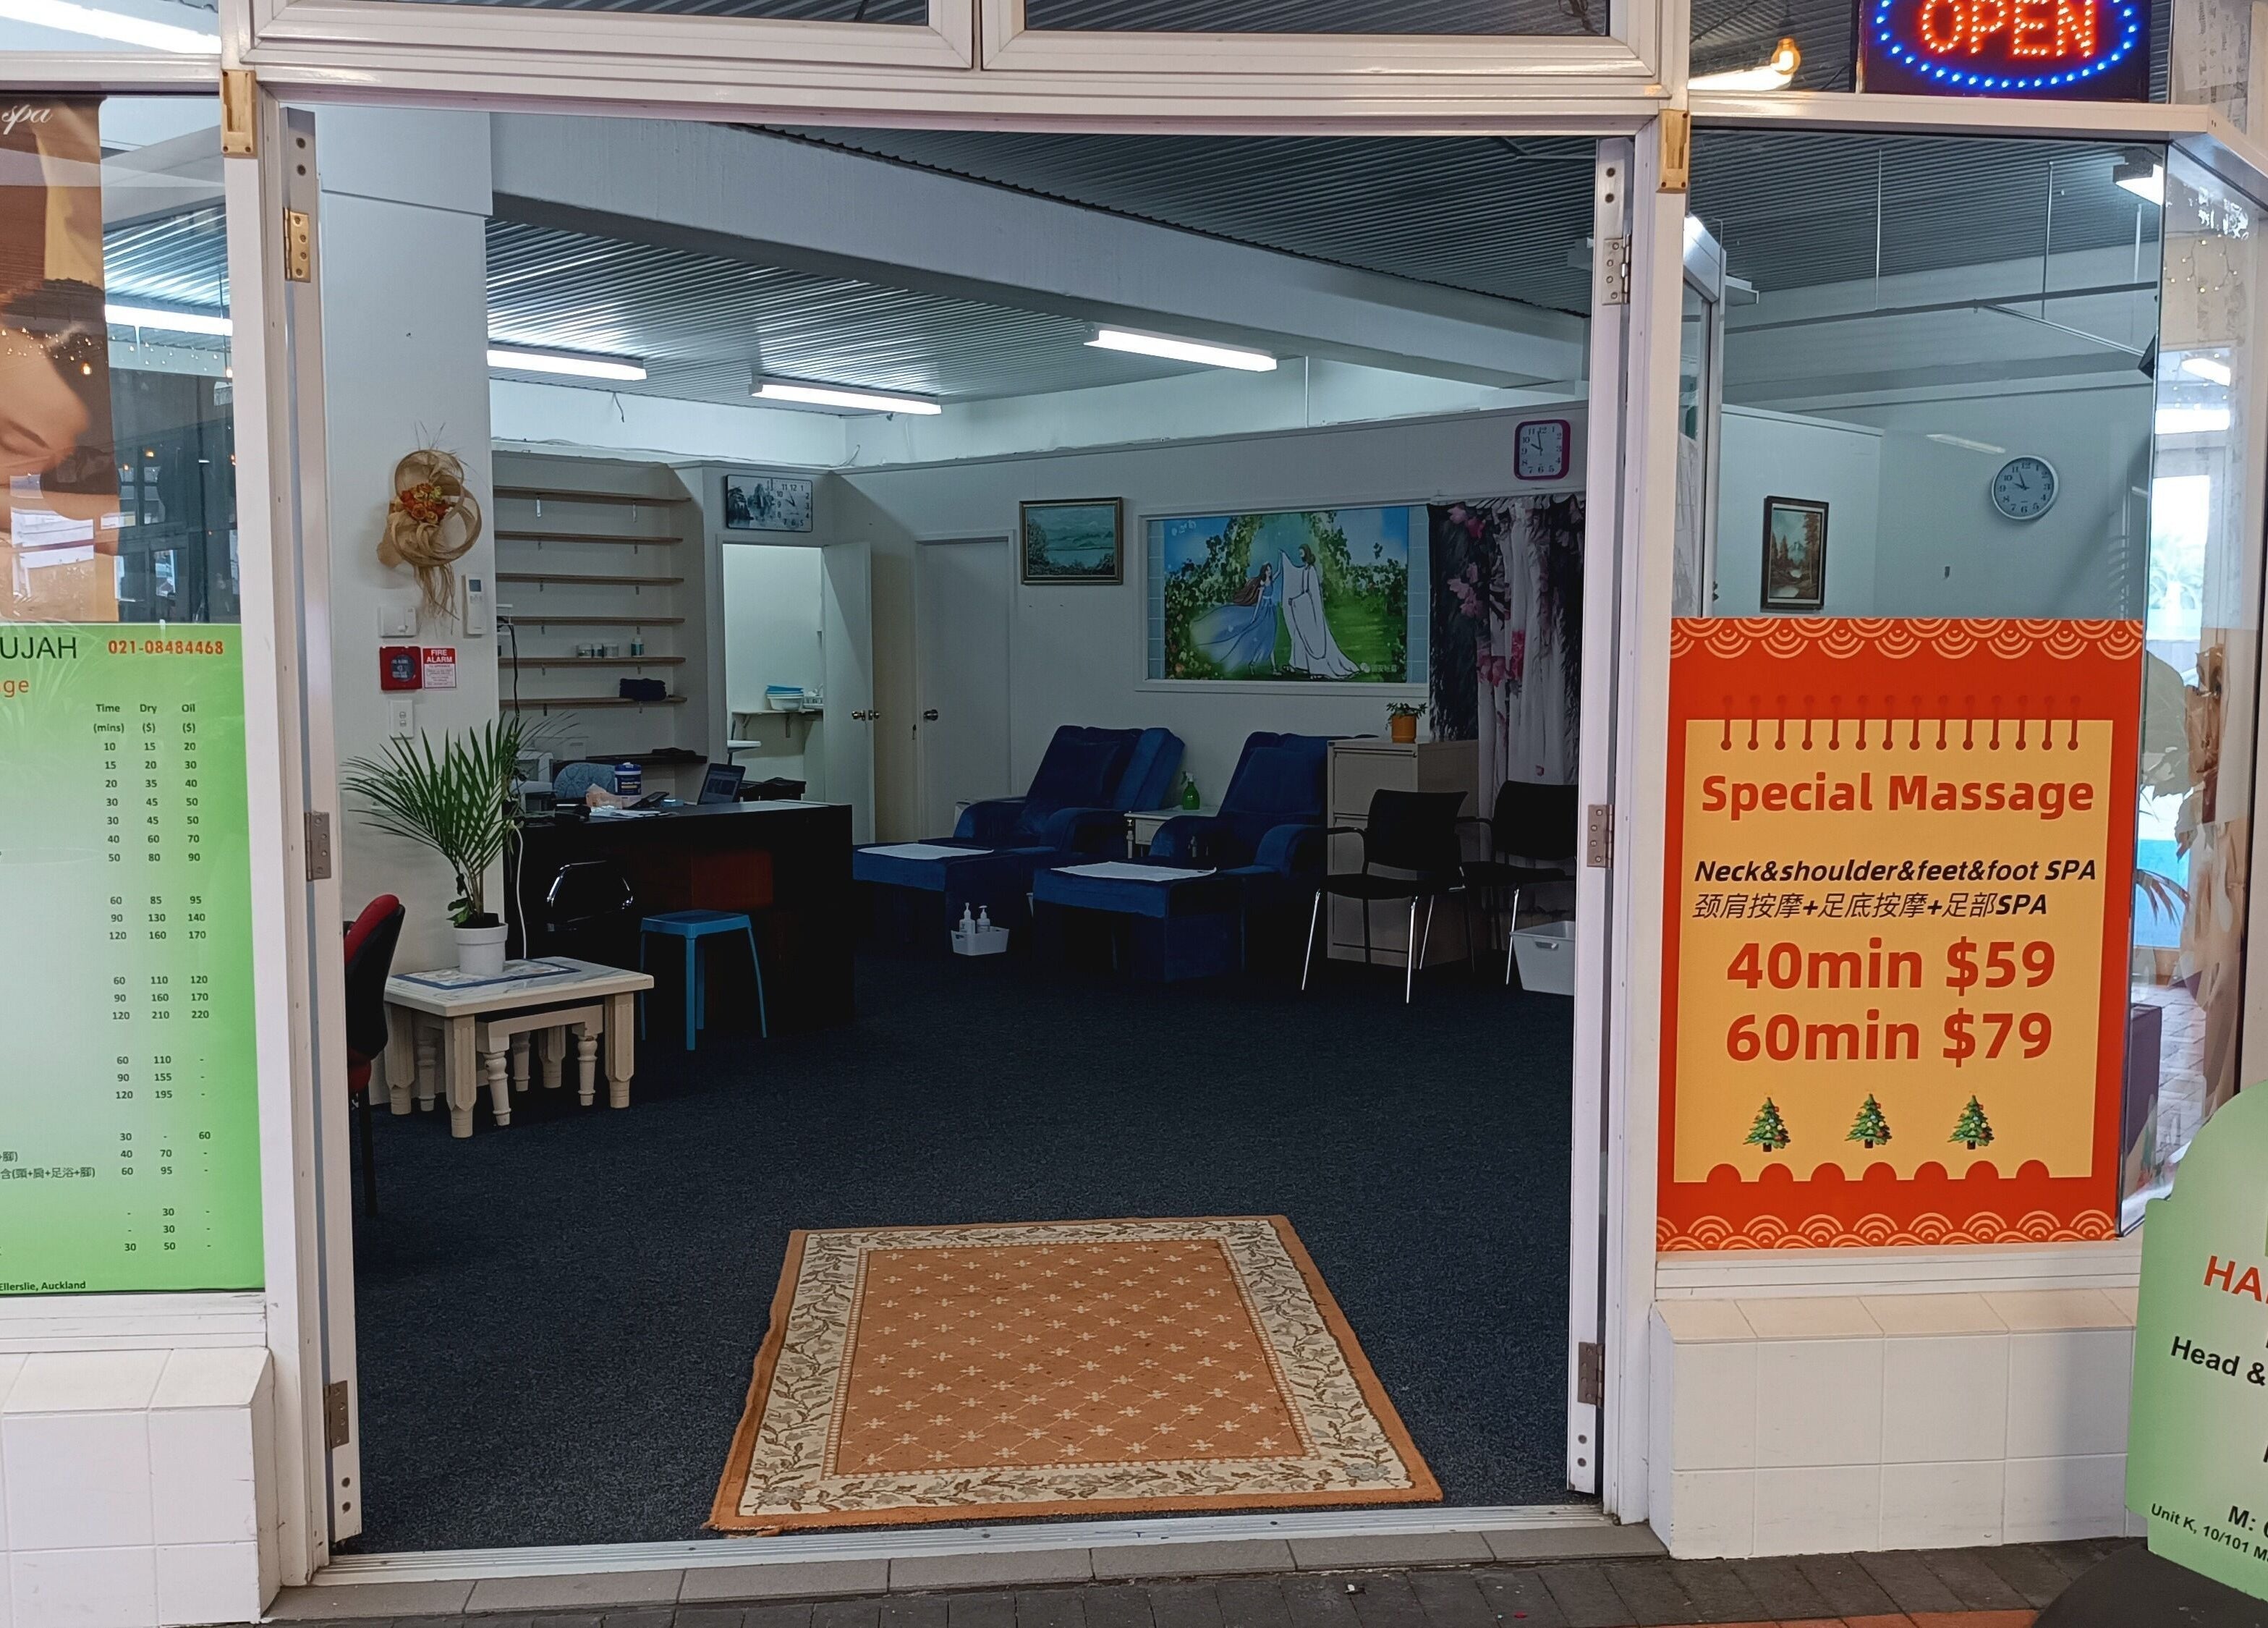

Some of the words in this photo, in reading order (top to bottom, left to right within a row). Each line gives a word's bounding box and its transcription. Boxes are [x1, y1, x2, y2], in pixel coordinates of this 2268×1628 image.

[1921, 0, 2097, 58] OPEN
[1, 104, 53, 135] spa
[0, 637, 77, 659] UJAH
[108, 640, 224, 654] 021-08484468
[0, 680, 29, 698] ge
[95, 703, 121, 713] Time
[139, 703, 158, 715] Dry
[181, 703, 196, 713] Oil
[93, 723, 124, 734] (mins)
[142, 722, 156, 734] ($)
[182, 722, 196, 734] ($)
[103, 742, 116, 751] 10
[144, 742, 156, 751] 15
[184, 742, 196, 751] 20
[104, 760, 117, 770] 15
[145, 760, 157, 770] 20
[184, 760, 198, 770] 30
[105, 779, 118, 788] 20
[145, 779, 158, 788] 35
[184, 779, 198, 788] 40
[1702, 771, 1874, 821] Special
[1888, 774, 2094, 821] Massage
[106, 797, 119, 807] 30
[145, 797, 158, 807] 45
[186, 797, 198, 807] 50
[106, 816, 119, 826] 30
[146, 815, 159, 825] 45
[187, 815, 200, 825] 50
[107, 834, 120, 844] 40
[147, 834, 160, 844] 60
[187, 834, 200, 844] 70
[108, 853, 121, 862] 50
[148, 853, 161, 862] 80
[187, 852, 201, 862] 90
[1694, 859, 2039, 882] Neck&shoulder&feet&foot
[2044, 859, 2097, 881] SPA
[110, 896, 122, 905] 60
[150, 896, 162, 905] 85
[190, 895, 202, 904] 95
[1691, 891, 2047, 918] 颈肩按摩+足底按摩+足部SPA
[110, 913, 123, 923] 90
[148, 913, 166, 923] 130
[188, 913, 206, 922] 140
[109, 931, 127, 941] 120
[149, 930, 167, 940] 160
[188, 930, 207, 939] 170
[1726, 937, 1923, 989] 40min
[1945, 936, 2055, 996] $59
[113, 976, 126, 985] 60
[150, 975, 169, 985] 110
[190, 975, 208, 985] 120
[114, 993, 127, 1003] 90
[151, 993, 169, 1002] 160
[191, 992, 209, 1001] 170
[112, 1011, 130, 1020] 120
[151, 1010, 170, 1019] 210
[191, 1010, 210, 1019] 220
[1725, 1009, 1920, 1061] 60min
[1942, 1007, 2053, 1068] $79
[116, 1056, 129, 1065] 60
[153, 1055, 172, 1064] 110
[116, 1073, 130, 1082] 90
[154, 1072, 172, 1082] 155
[116, 1090, 134, 1100] 120
[155, 1090, 173, 1099] 195
[119, 1132, 132, 1141] 30
[198, 1131, 211, 1140] 60
[120, 1150, 133, 1158] 40
[159, 1149, 173, 1158] 70
[121, 1166, 134, 1176] 60
[160, 1166, 173, 1175] 95
[162, 1208, 175, 1216] 30
[163, 1224, 176, 1234] 30
[124, 1242, 137, 1252] 30
[163, 1242, 176, 1251] 50
[2204, 1255, 2268, 1304] HA
[41, 1281, 86, 1289] Auckland
[2170, 1336, 2241, 1376] Head
[2246, 1362, 2266, 1386] &
[2227, 1505, 2256, 1532] M:
[2151, 1503, 2180, 1525] Unit
[2183, 1517, 2198, 1534] K,
[2203, 1525, 2249, 1553] 10/101
